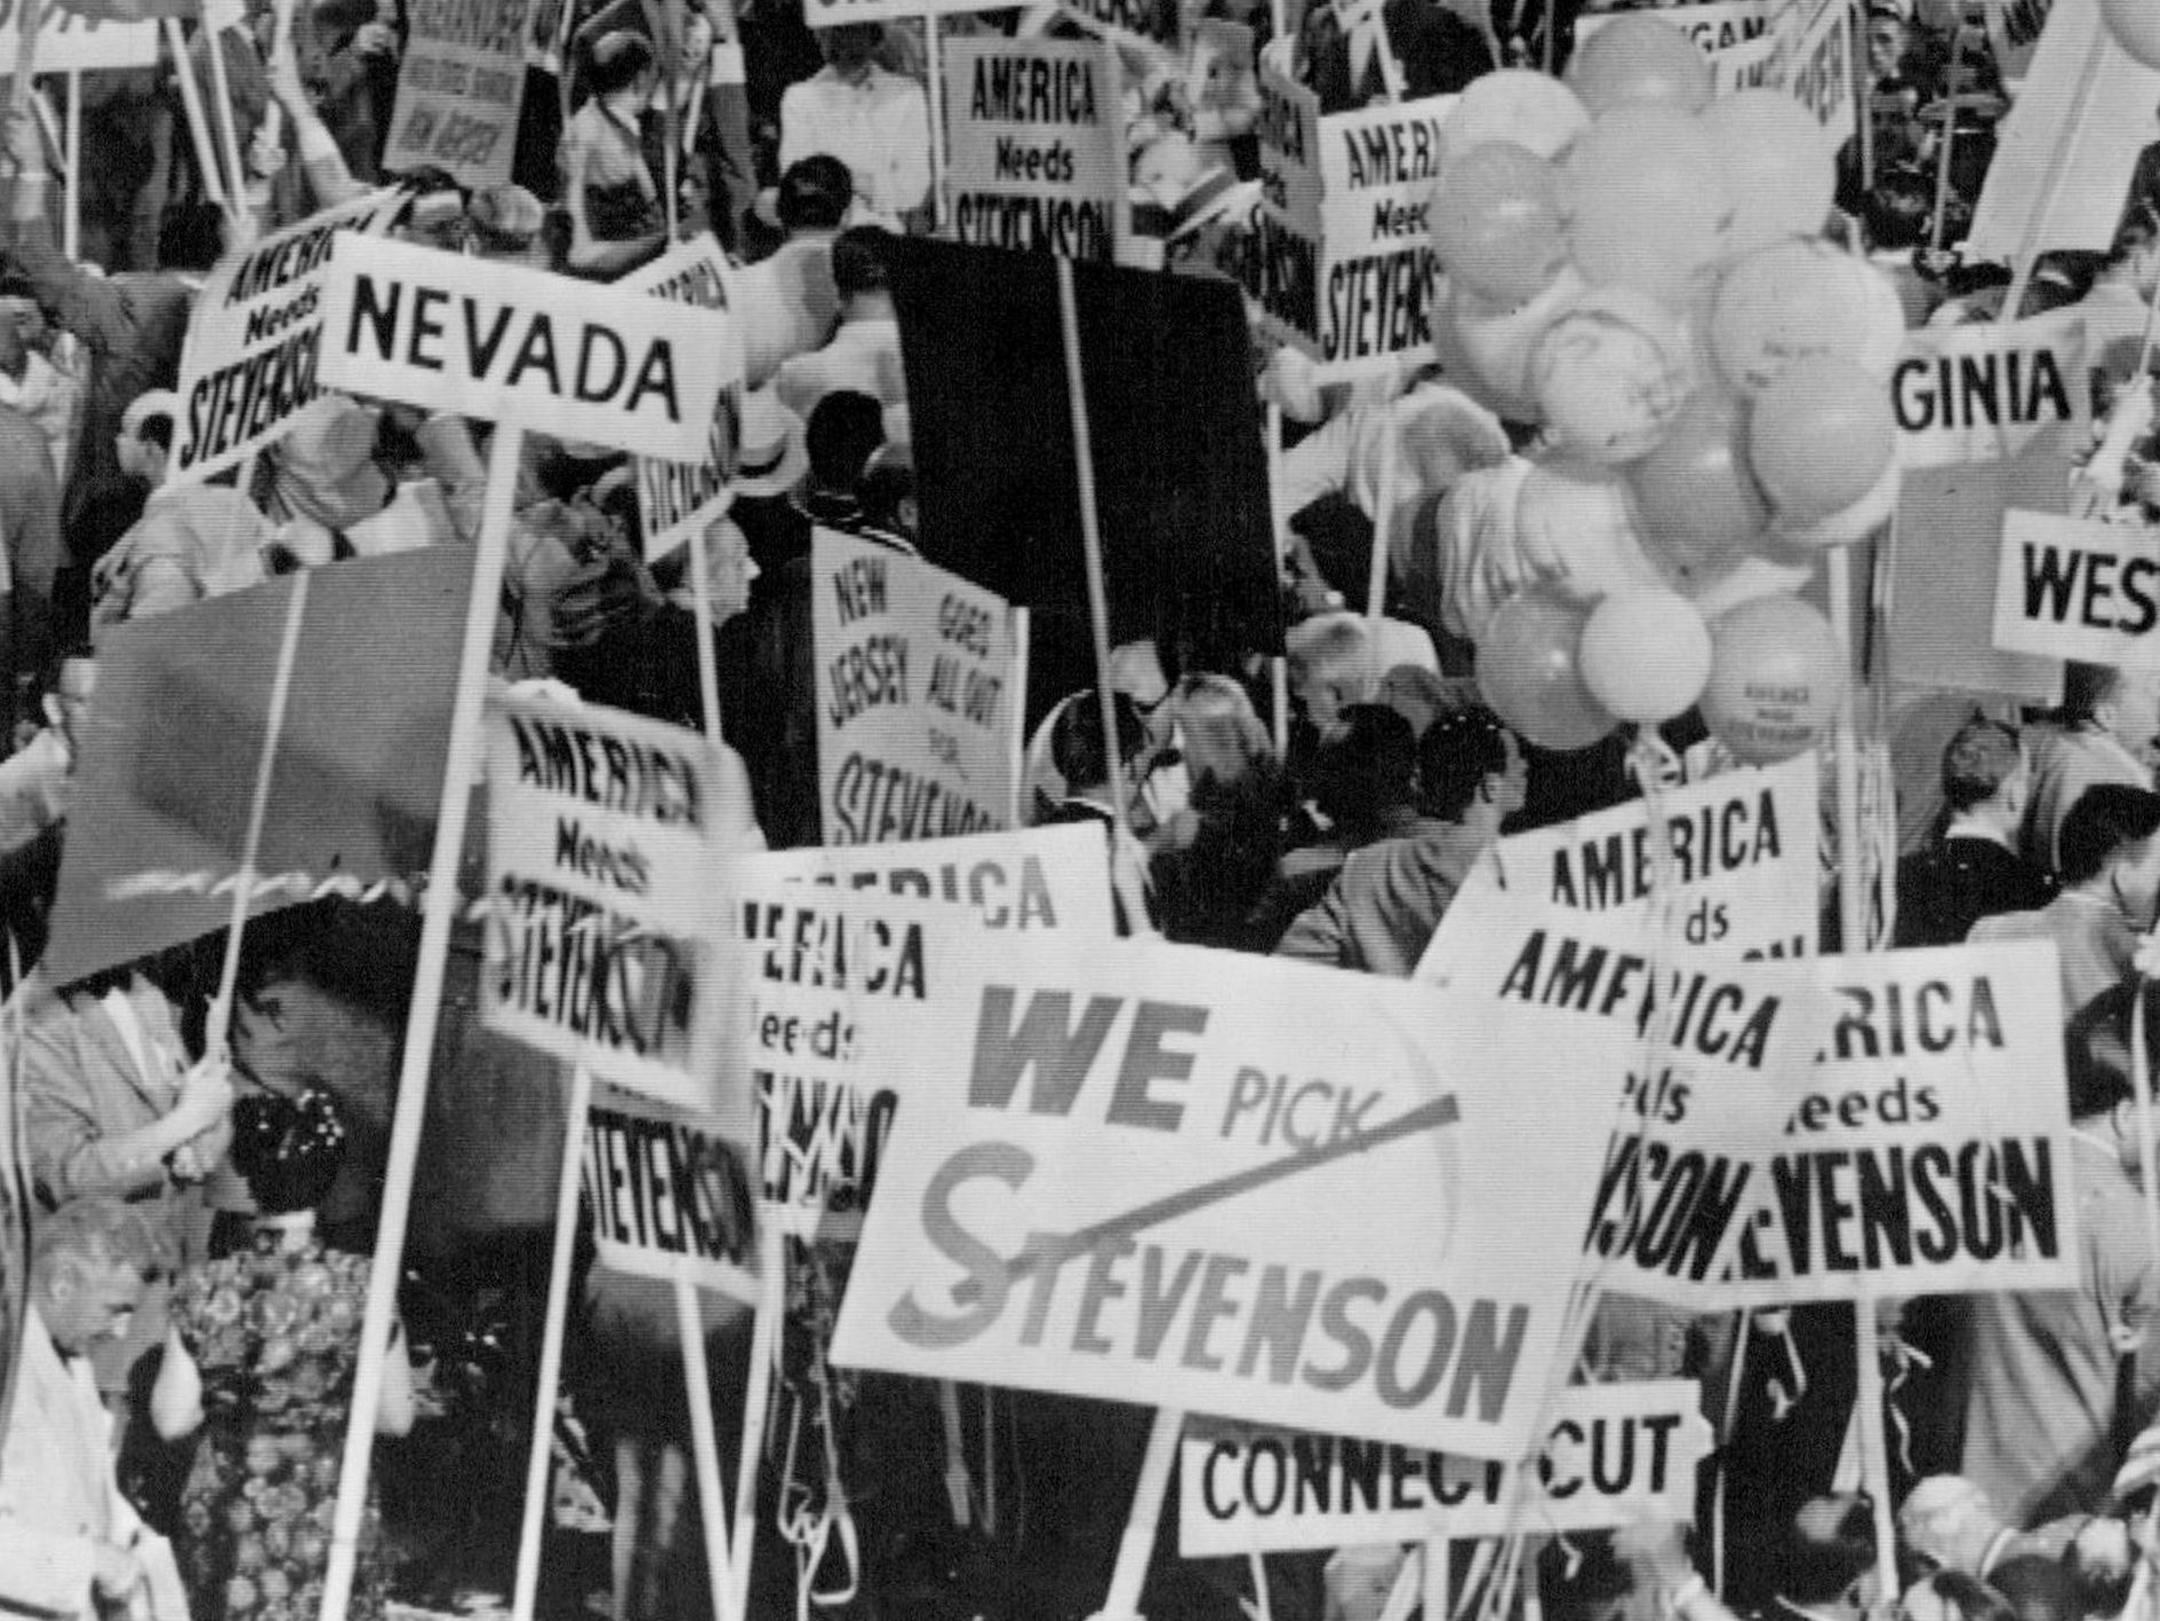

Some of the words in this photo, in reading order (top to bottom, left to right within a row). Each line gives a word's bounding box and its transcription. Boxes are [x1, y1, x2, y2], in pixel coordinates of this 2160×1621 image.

[972, 57, 1098, 124] AMERICA
[995, 137, 1074, 182] Needs
[347, 273, 682, 423] NEVADA
[834, 556, 888, 627] NEW
[2023, 541, 2160, 635] WES
[829, 633, 909, 731] JERSEY
[966, 984, 1211, 1133] WE
[1220, 1065, 1385, 1153] PICK
[1784, 1076, 1942, 1136] eeds
[886, 1140, 1531, 1426] STEVENSON
[1203, 1413, 1684, 1520] CONNECCUT
